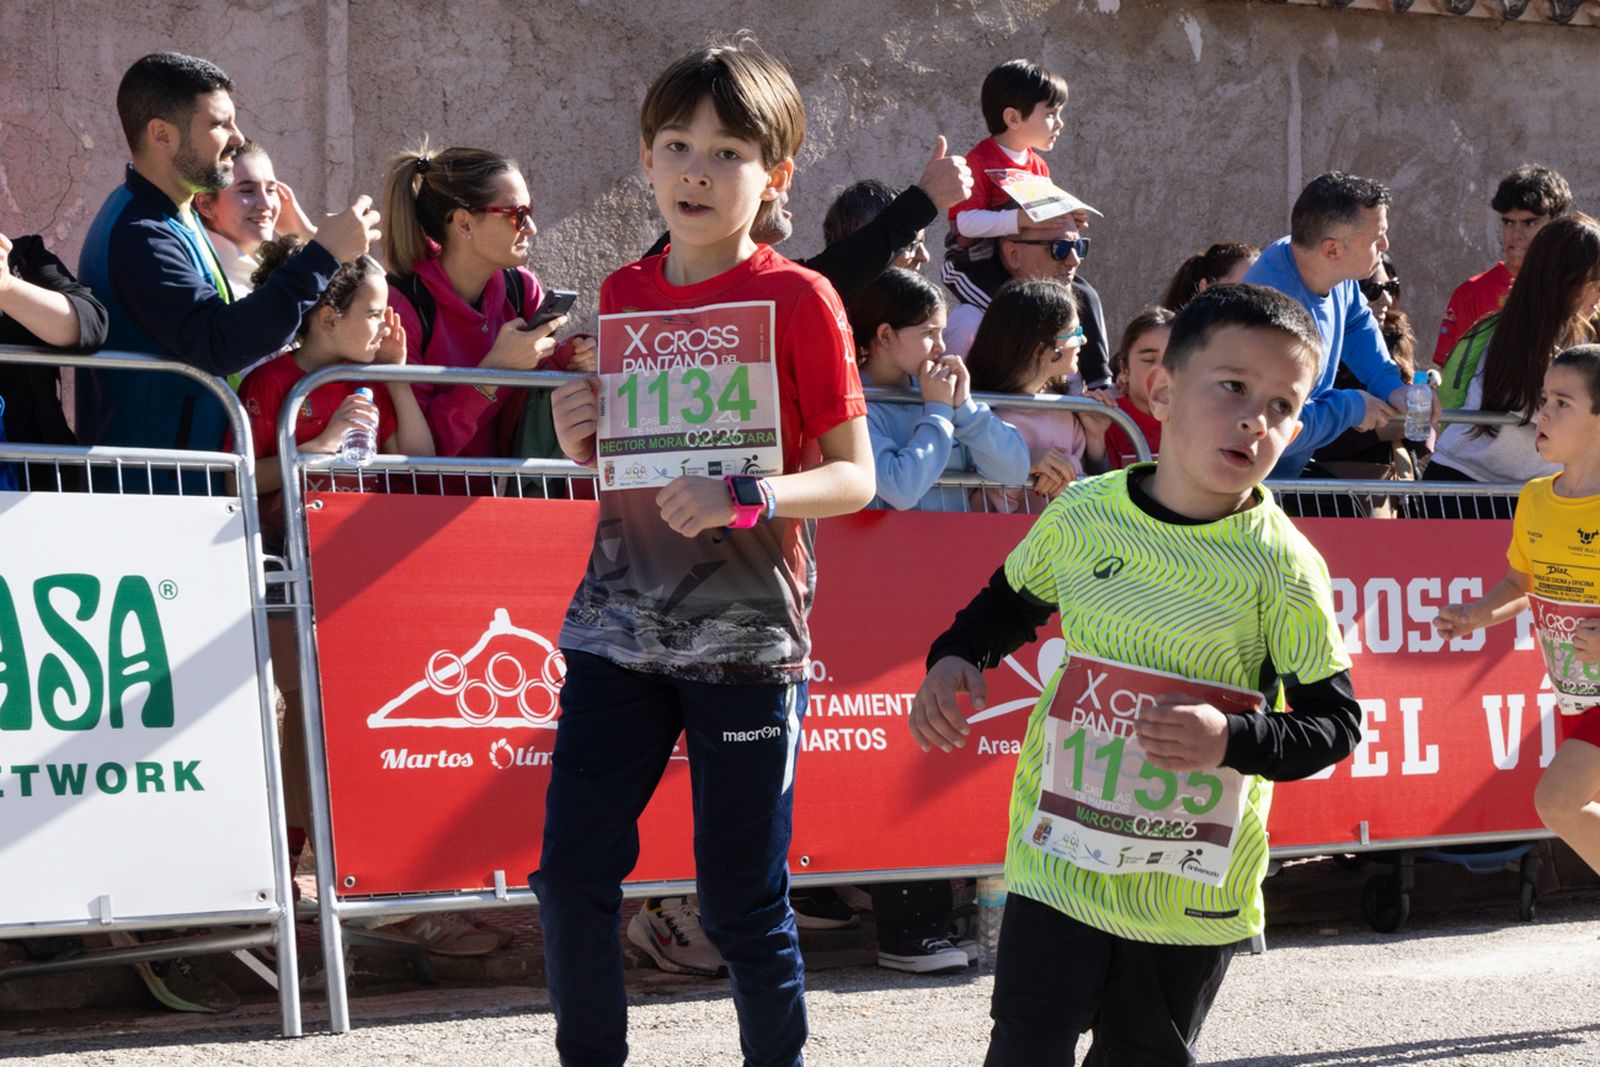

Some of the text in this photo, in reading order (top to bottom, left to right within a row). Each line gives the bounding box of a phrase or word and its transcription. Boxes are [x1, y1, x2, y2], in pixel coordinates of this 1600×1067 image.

[624, 324, 649, 355] X
[654, 325, 740, 354] CROSS
[622, 351, 718, 377] PANTANO
[617, 365, 757, 429] 1134
[600, 439, 646, 453] HECTOR
[1076, 669, 1109, 710] X
[722, 725, 781, 742] macron
[1071, 707, 1137, 744] PANT
[380, 737, 554, 770] Martos Olím
[977, 736, 1021, 755] Area
[0, 760, 205, 797] TWORK
[1076, 806, 1134, 833] MARCOS
